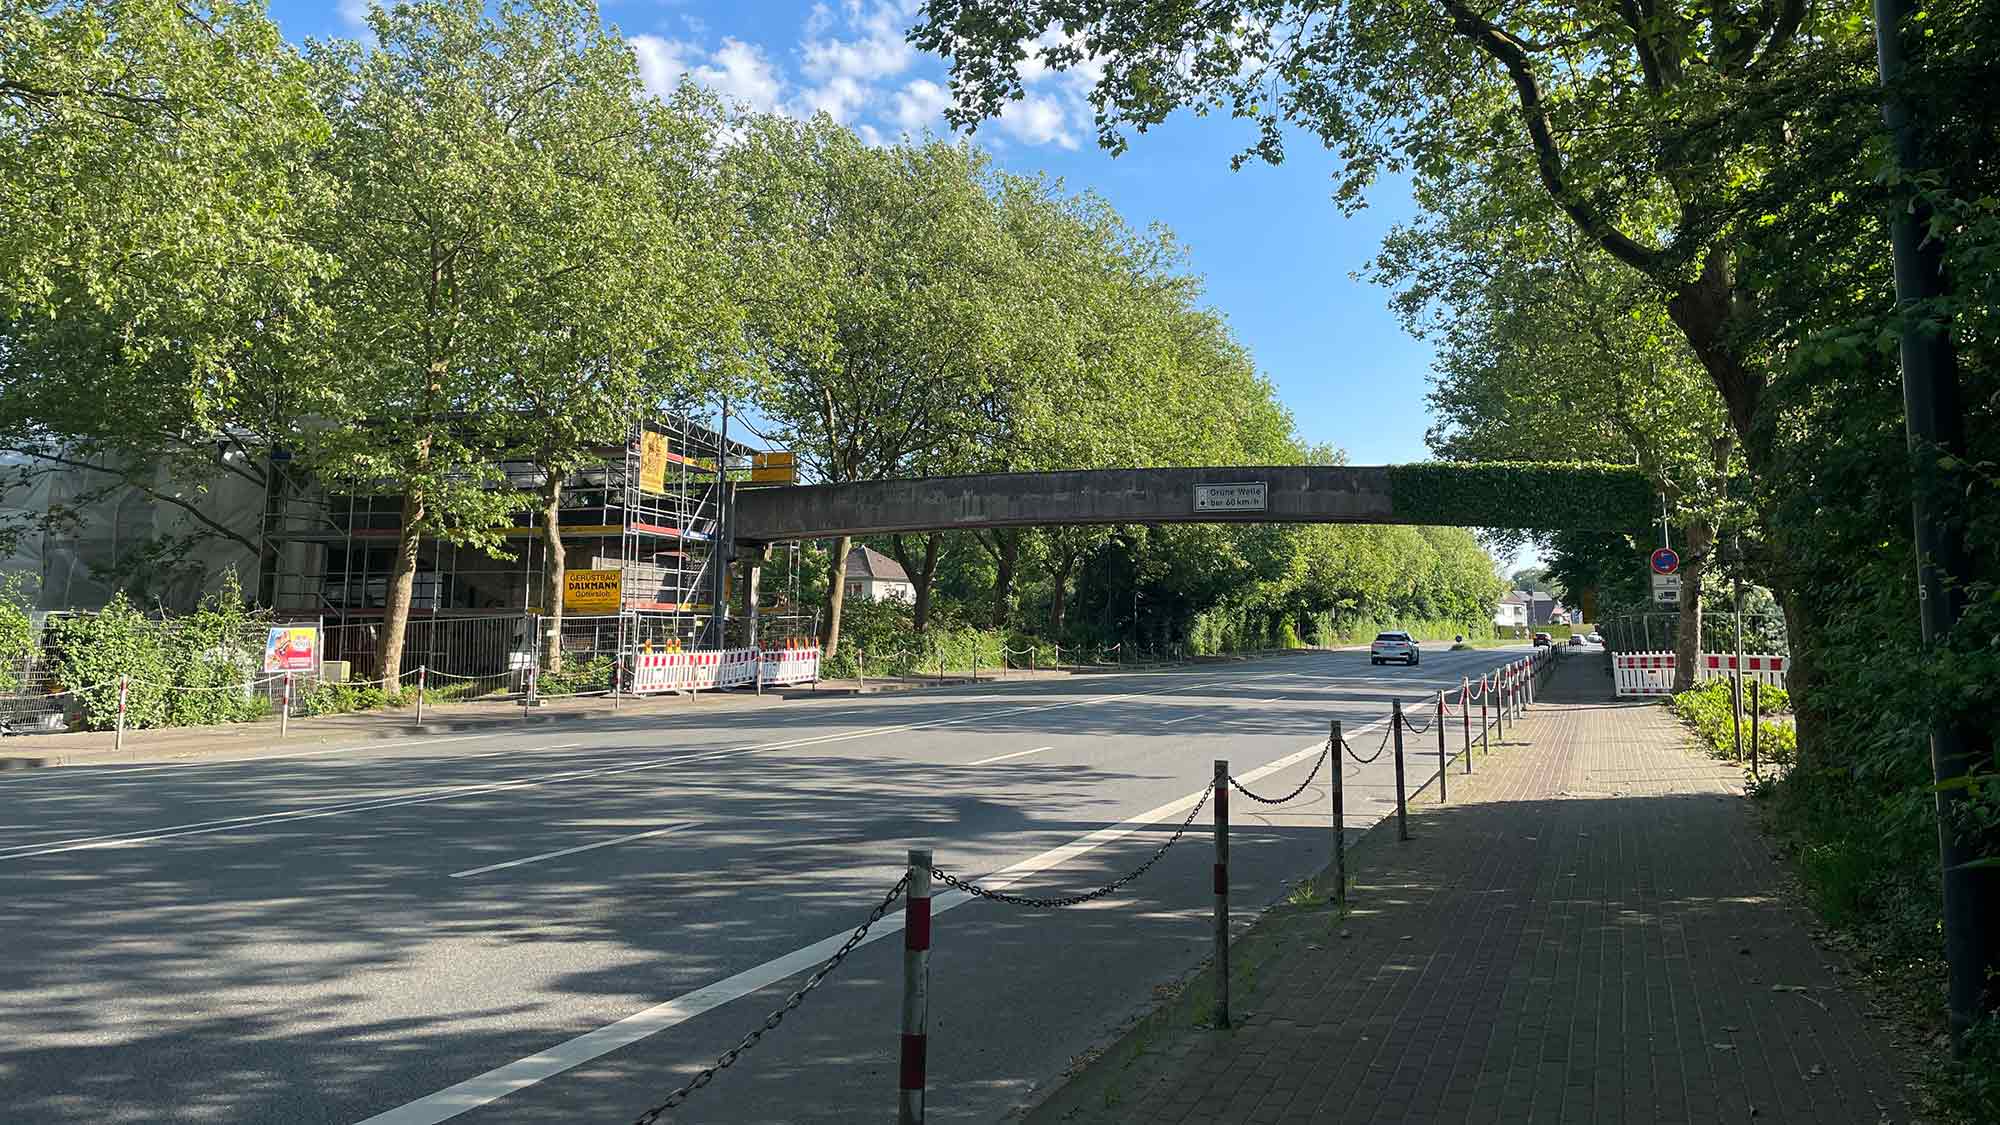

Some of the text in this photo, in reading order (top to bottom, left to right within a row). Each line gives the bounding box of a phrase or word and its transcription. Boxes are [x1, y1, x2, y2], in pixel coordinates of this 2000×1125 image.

[1239, 487, 1262, 496] Welle
[569, 573, 616, 581] GERÜSTBAU
[568, 582, 618, 590] DALKMANN
